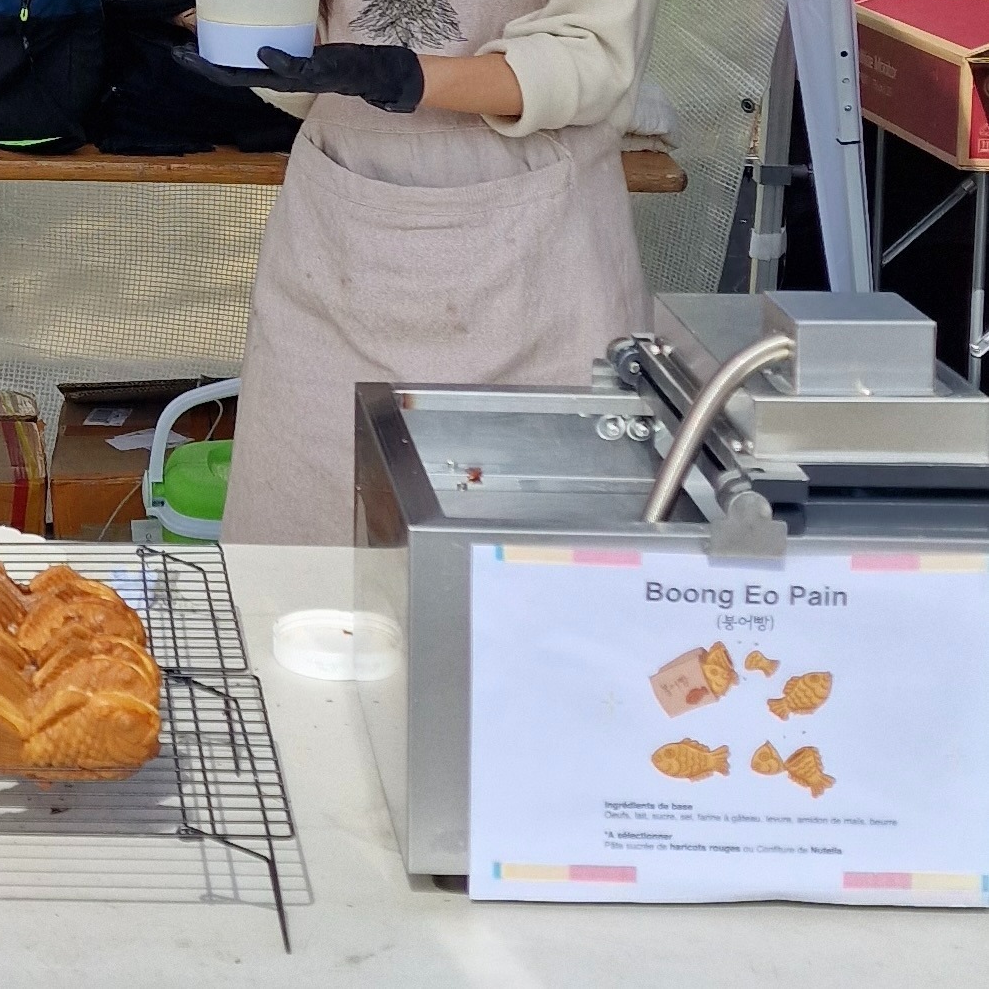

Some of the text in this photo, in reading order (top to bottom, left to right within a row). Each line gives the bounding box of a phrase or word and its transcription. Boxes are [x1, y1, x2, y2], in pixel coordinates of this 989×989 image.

[646, 582, 847, 609] Boong Eo Pain
[717, 615, 774, 631] (붕어빵)
[671, 802, 693, 810] base
[670, 843, 706, 851] haricots
[710, 844, 740, 853] rouges
